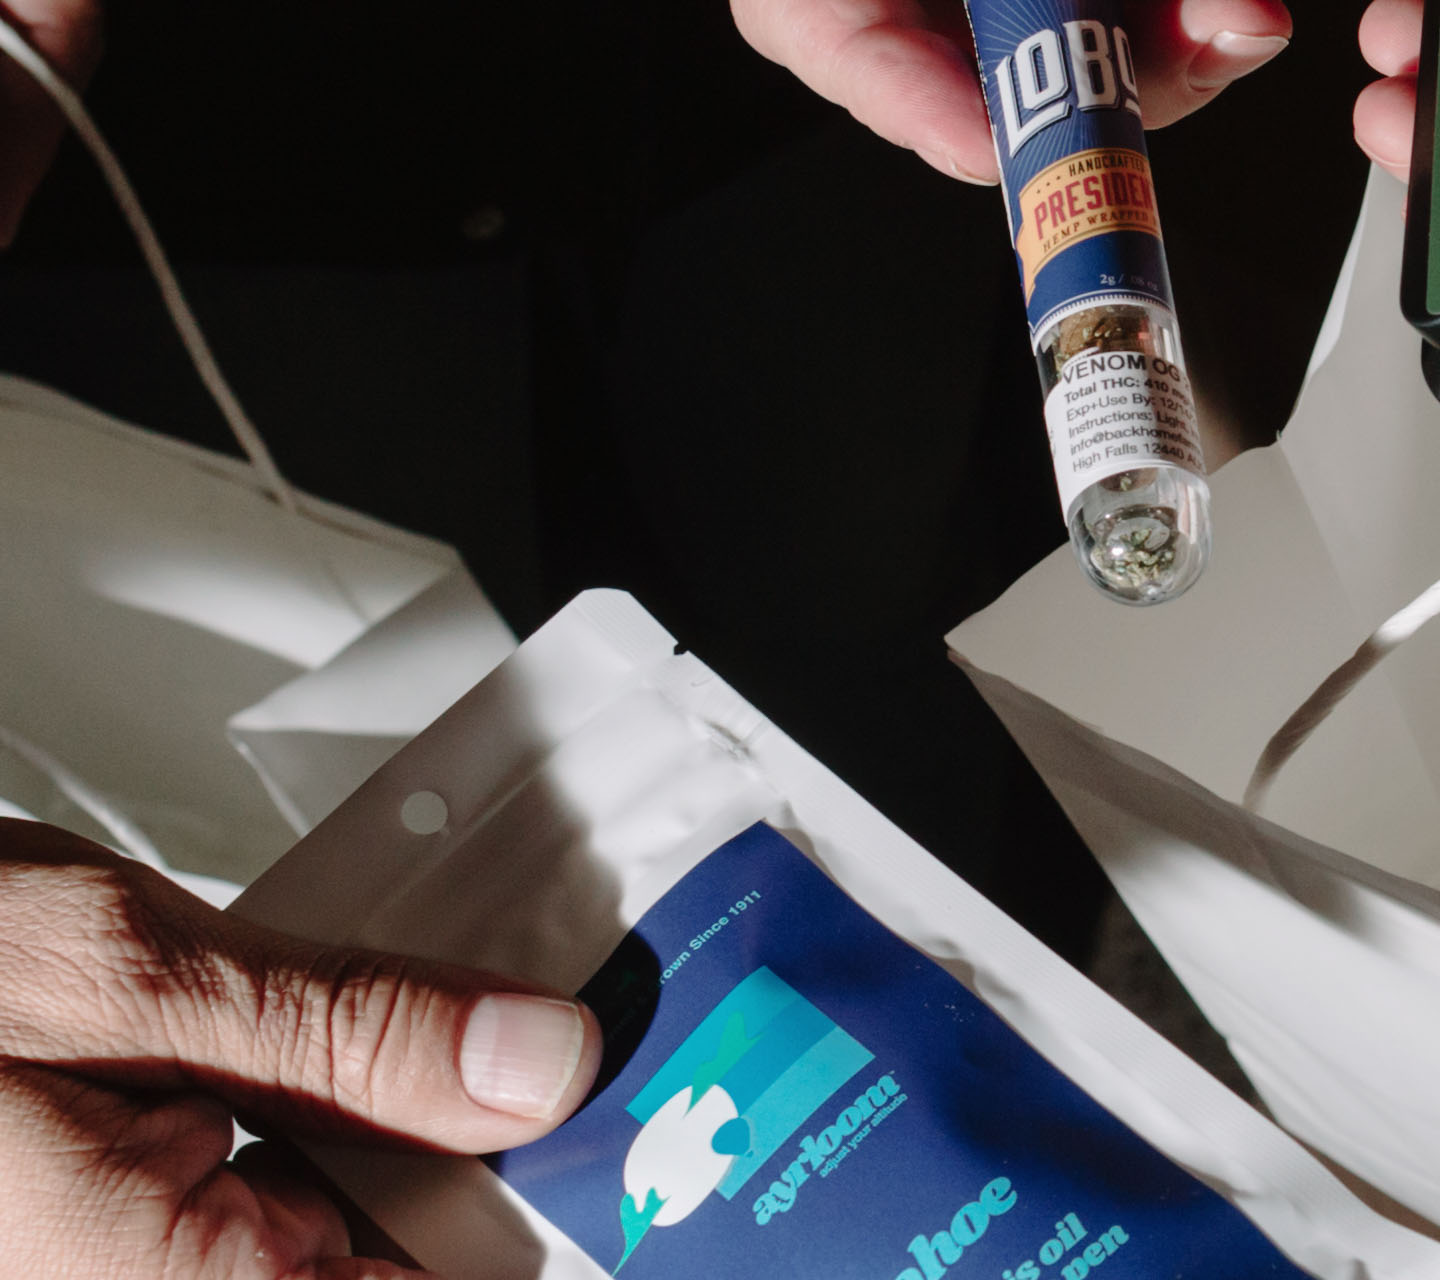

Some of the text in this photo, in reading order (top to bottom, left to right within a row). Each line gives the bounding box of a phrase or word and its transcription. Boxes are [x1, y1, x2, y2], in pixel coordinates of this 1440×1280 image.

[1042, 222, 1081, 254] HEMP
[1086, 209, 1149, 228] WRAPPED
[1062, 354, 1147, 385] VENOM
[1152, 357, 1182, 383] OG
[1063, 381, 1098, 405] Total
[1101, 376, 1140, 391] THC:
[1143, 378, 1170, 394] 410
[1066, 396, 1128, 422] Exp+Use
[1131, 393, 1157, 407] By:
[1068, 410, 1153, 439] Instructions:
[1072, 451, 1102, 473] High
[1105, 442, 1139, 459] Falls
[1143, 442, 1186, 461] 12440
[688, 916, 730, 951] Since
[728, 890, 762, 919] 1911
[751, 1074, 902, 1226] ayrloom
[818, 1091, 908, 1179] adjust your altitude
[1038, 1212, 1089, 1266] oil
